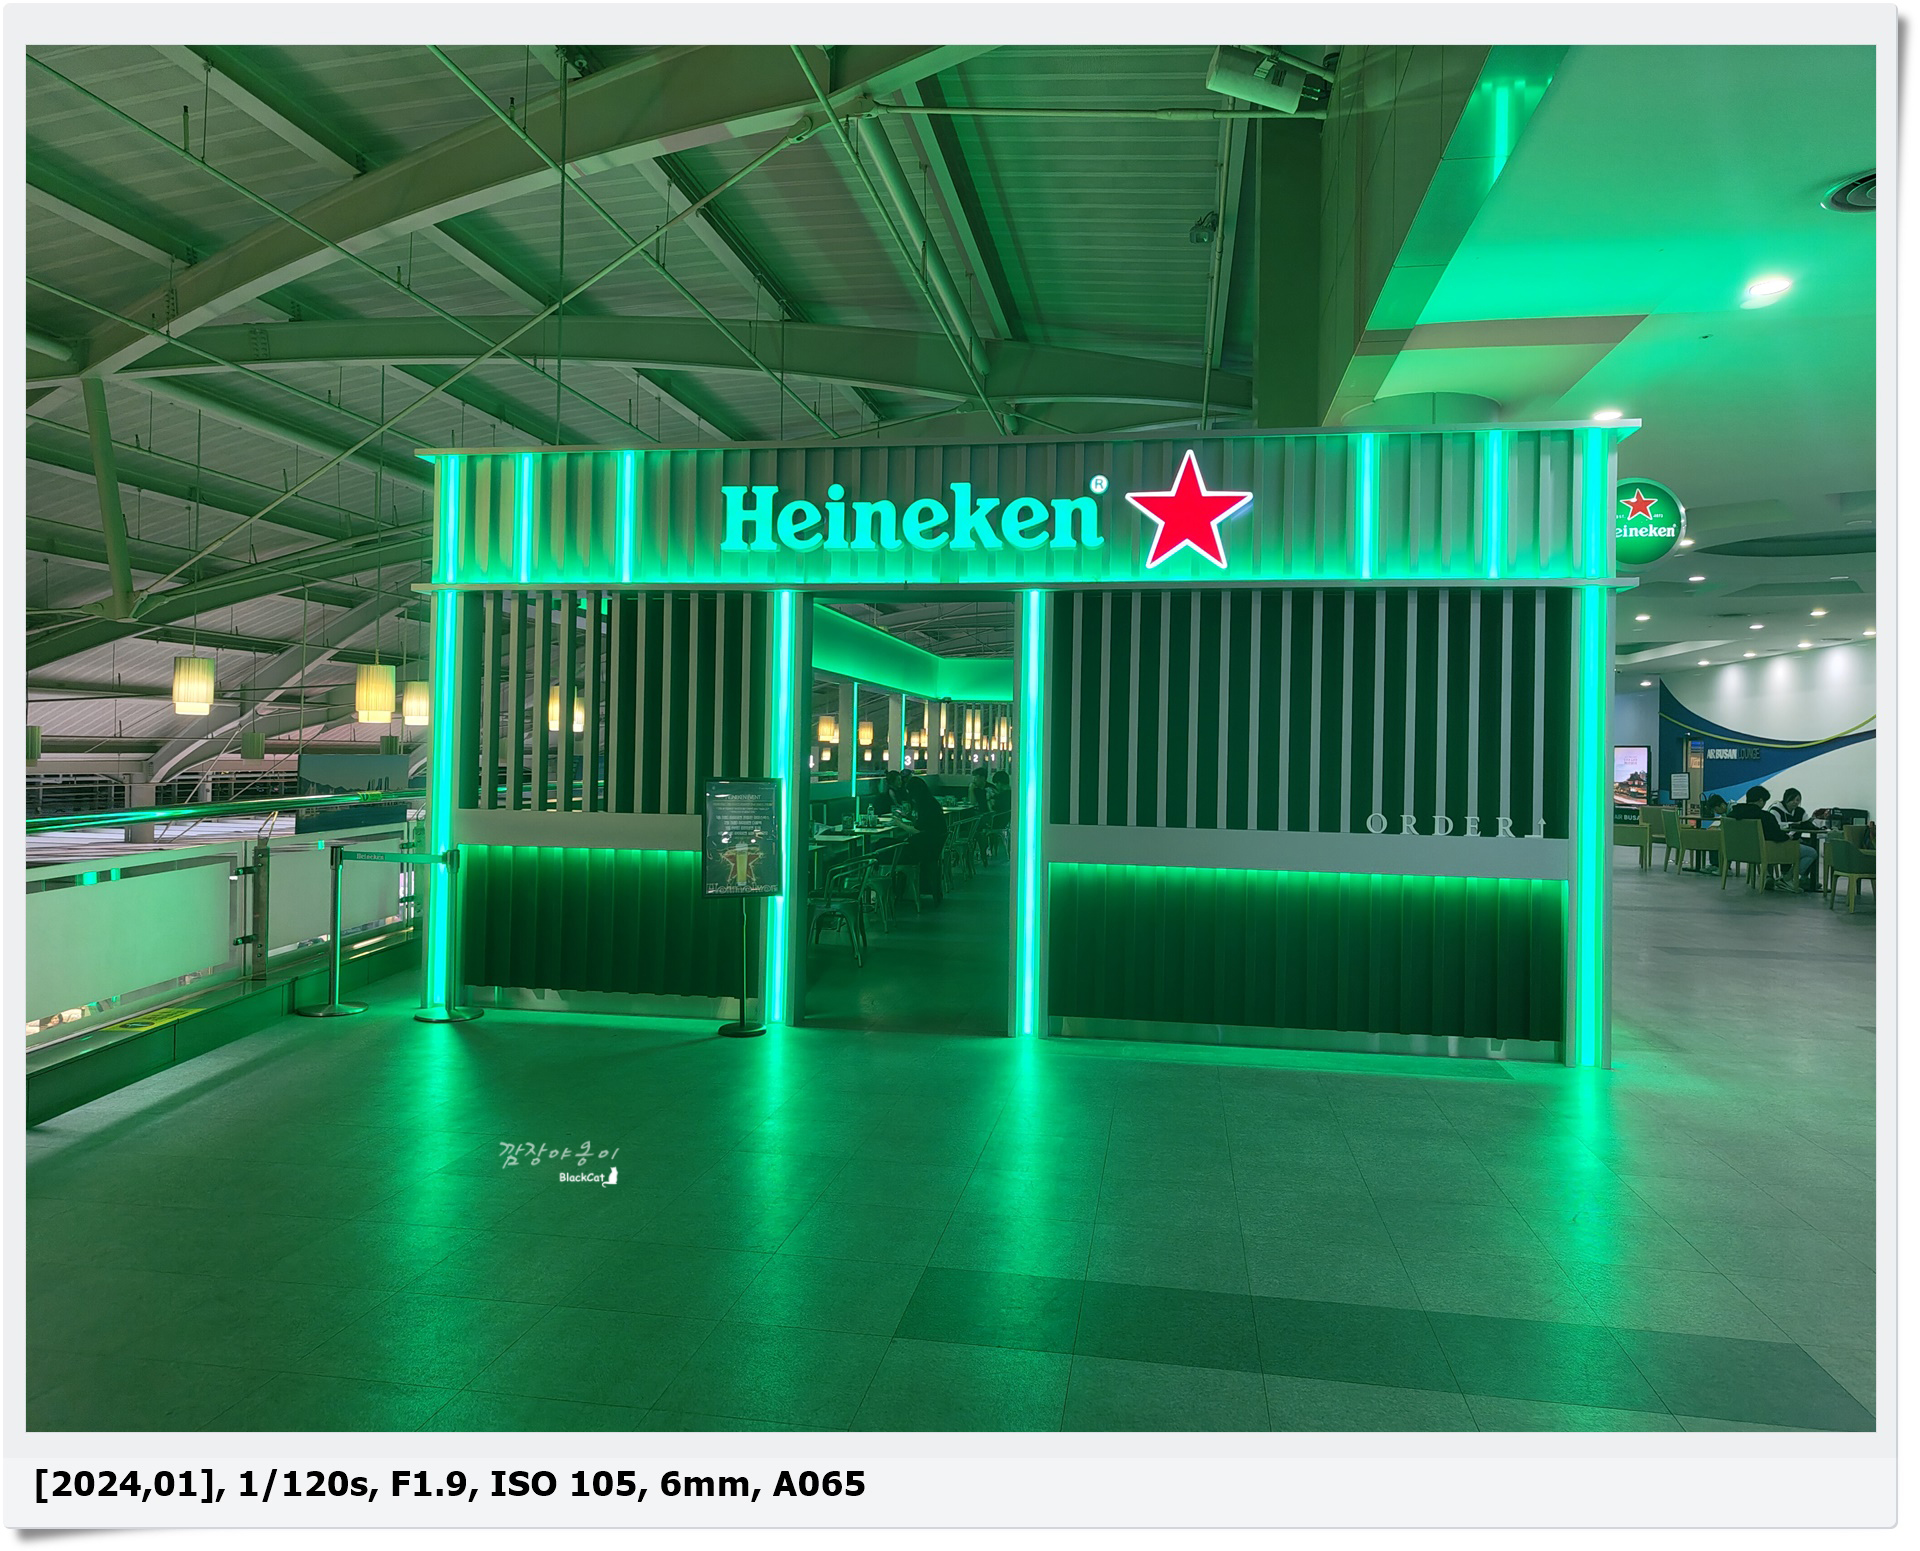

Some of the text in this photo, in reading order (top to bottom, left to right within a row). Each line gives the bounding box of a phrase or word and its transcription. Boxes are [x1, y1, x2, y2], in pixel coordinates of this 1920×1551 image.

[720, 482, 1105, 552] Heineken
[1616, 523, 1676, 538] eineken
[904, 755, 912, 765] 3
[973, 754, 979, 762] 2
[1716, 749, 1738, 759] BUSAN
[1738, 748, 1760, 759] LOUNGE
[1366, 812, 1516, 838] ORDER
